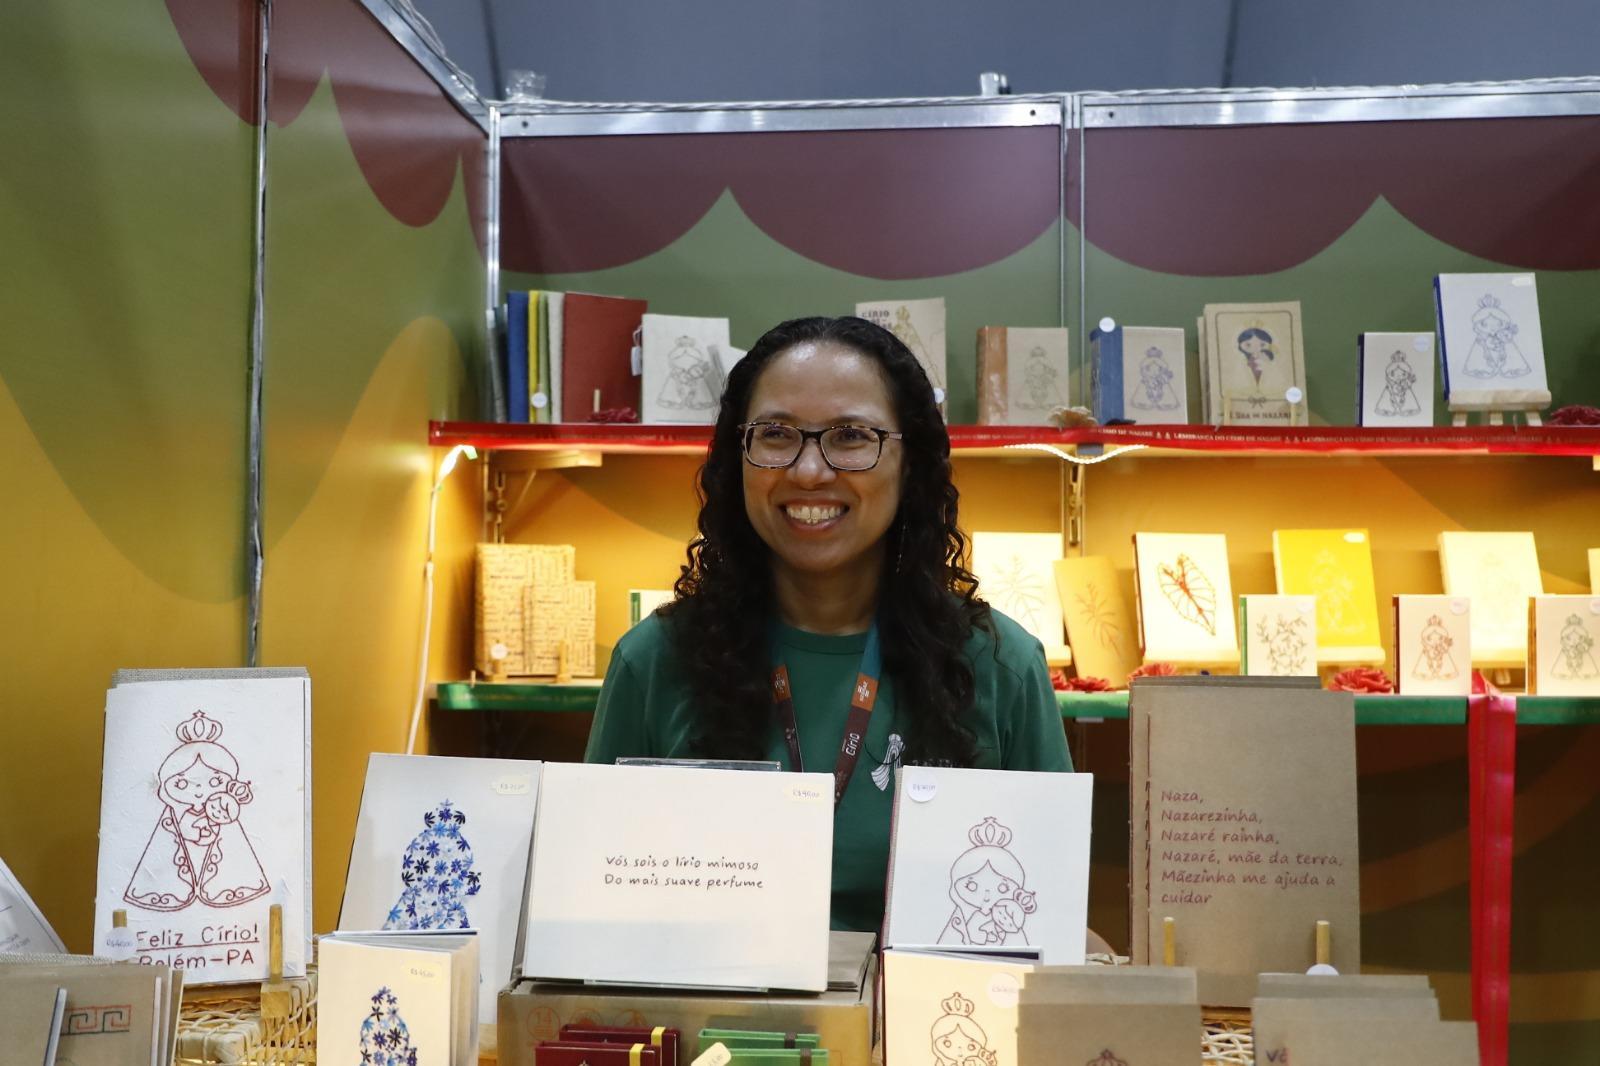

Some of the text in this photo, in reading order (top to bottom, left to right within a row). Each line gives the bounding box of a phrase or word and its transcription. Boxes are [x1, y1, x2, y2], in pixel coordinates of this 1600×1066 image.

[1161, 790, 1204, 804] Naza,
[1161, 807, 1263, 825] Nazarezinha,
[1161, 828, 1215, 842] Nazaré
[606, 855, 759, 871] Vós sois o lírio mimoso
[1162, 850, 1220, 865] Nazaré,
[1228, 852, 1263, 864] mãe
[1269, 852, 1289, 864] da
[604, 873, 764, 890] Do mais suave perfume
[1161, 869, 1336, 890] Mãezinha me ajuda a
[1161, 889, 1213, 904] cuidar
[136, 923, 259, 946] Feliz Círio!
